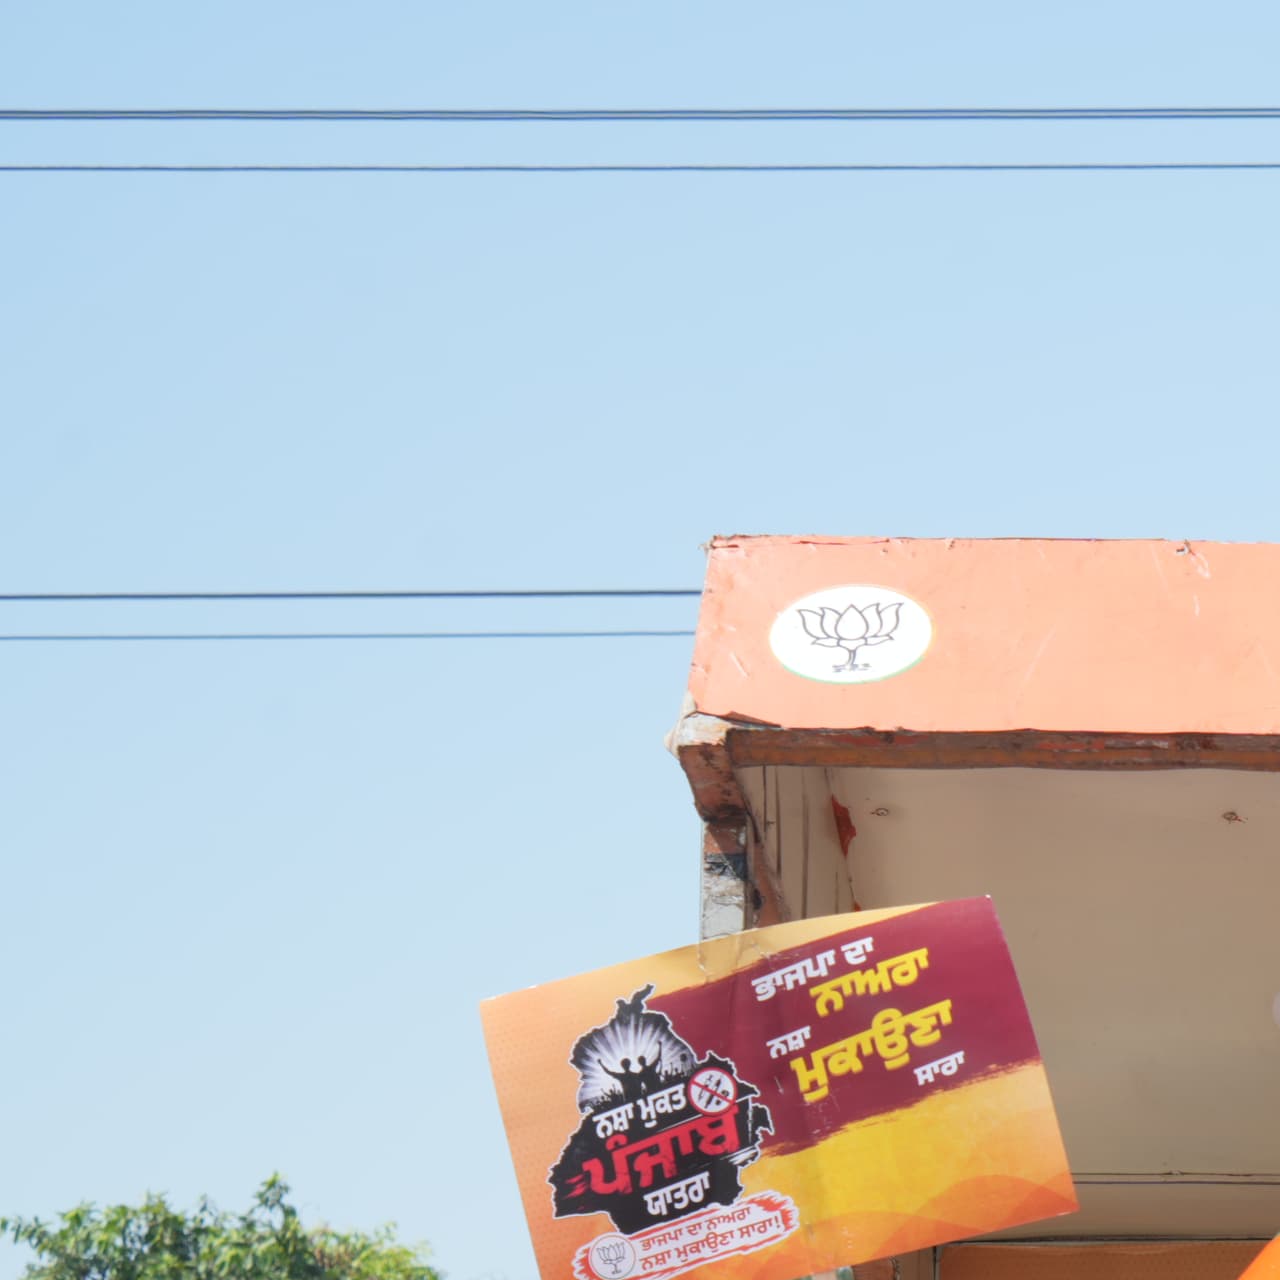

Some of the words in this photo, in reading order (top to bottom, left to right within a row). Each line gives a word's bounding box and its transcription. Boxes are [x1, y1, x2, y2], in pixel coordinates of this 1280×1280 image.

[752, 950, 835, 1002] ਭਾਜਪਾ
[841, 937, 874, 965] ਦਾ
[809, 948, 928, 1017] ਨਾਅਰਾ
[790, 999, 952, 1102] ਮੁਕਾਉਣਾ
[913, 1050, 964, 1085] ਸਾਰਾ
[637, 1083, 687, 1128] ਮੁਕਤ
[582, 1104, 740, 1194] ਪੰਜਾਬ
[643, 1171, 710, 1216] ਯਾਤਰਾ
[640, 1229, 683, 1251] ਭਾਜਪਾ
[687, 1222, 703, 1235] ਦਾ
[704, 1207, 752, 1230] ਨਾਅਰਾ
